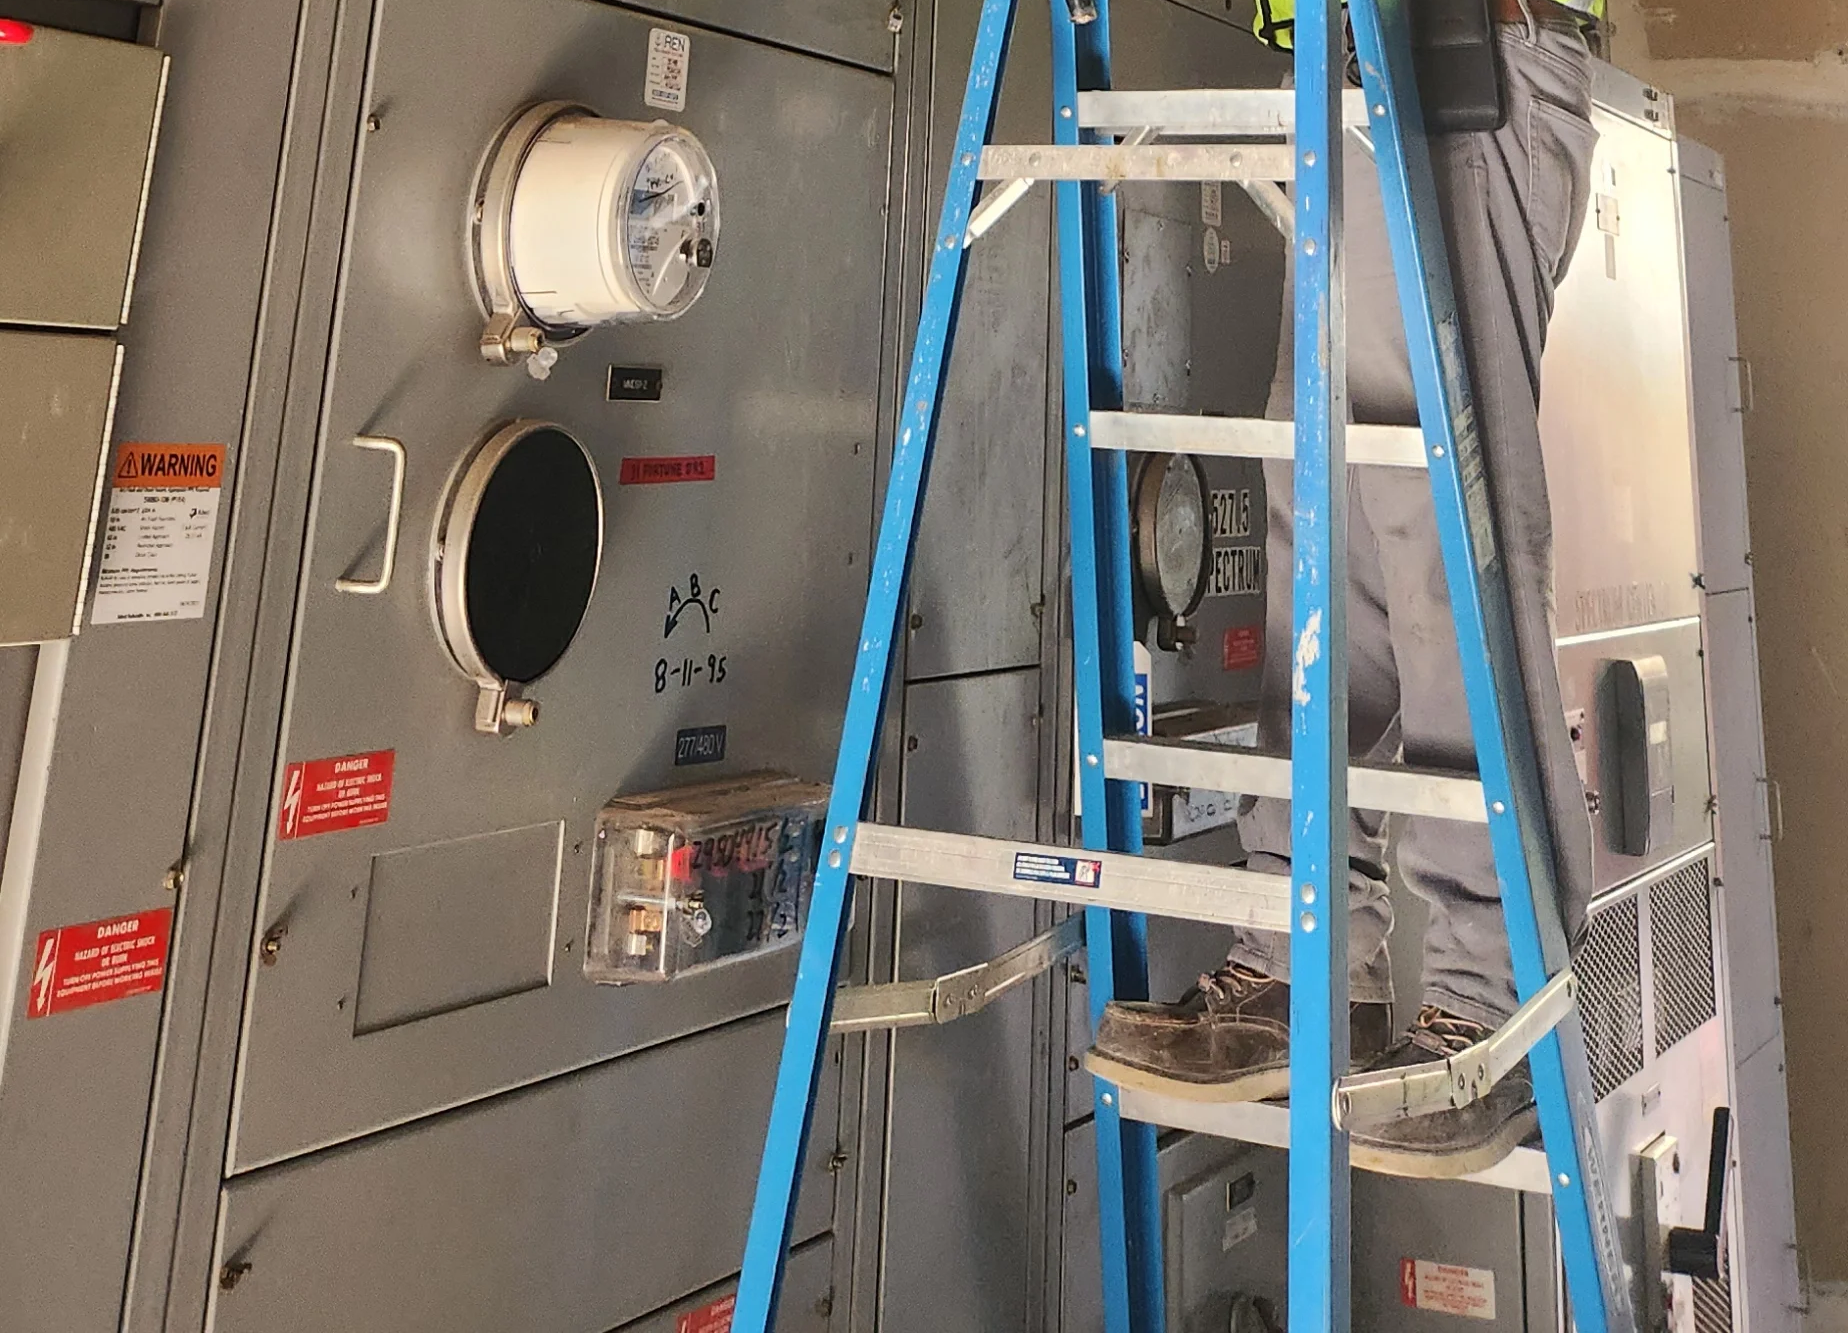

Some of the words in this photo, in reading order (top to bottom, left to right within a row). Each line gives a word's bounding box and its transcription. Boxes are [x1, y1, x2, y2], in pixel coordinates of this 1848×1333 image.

[140, 453, 217, 477] WARNING
[669, 586, 682, 612] A
[689, 573, 701, 598] B
[709, 588, 721, 614] C
[655, 653, 727, 693] 8-11-95
[334, 758, 369, 773] DANGER
[97, 919, 140, 939] DANGER
[74, 947, 100, 961] HAZARD
[101, 946, 109, 955] OF
[110, 941, 135, 954] ELECTRIC
[136, 936, 156, 947] SHOCK
[101, 956, 110, 967] OR
[111, 953, 128, 965] BURN
[56, 984, 92, 998] EQUIPMENT
[92, 979, 114, 990] BEFORE
[114, 972, 144, 985] WORKING
[144, 967, 163, 978] INSIDE
[63, 976, 80, 986] TURN
[80, 973, 91, 982] OFF
[92, 969, 114, 979] POWER
[114, 961, 145, 975] SUPPLYING
[145, 958, 159, 967] THIS
